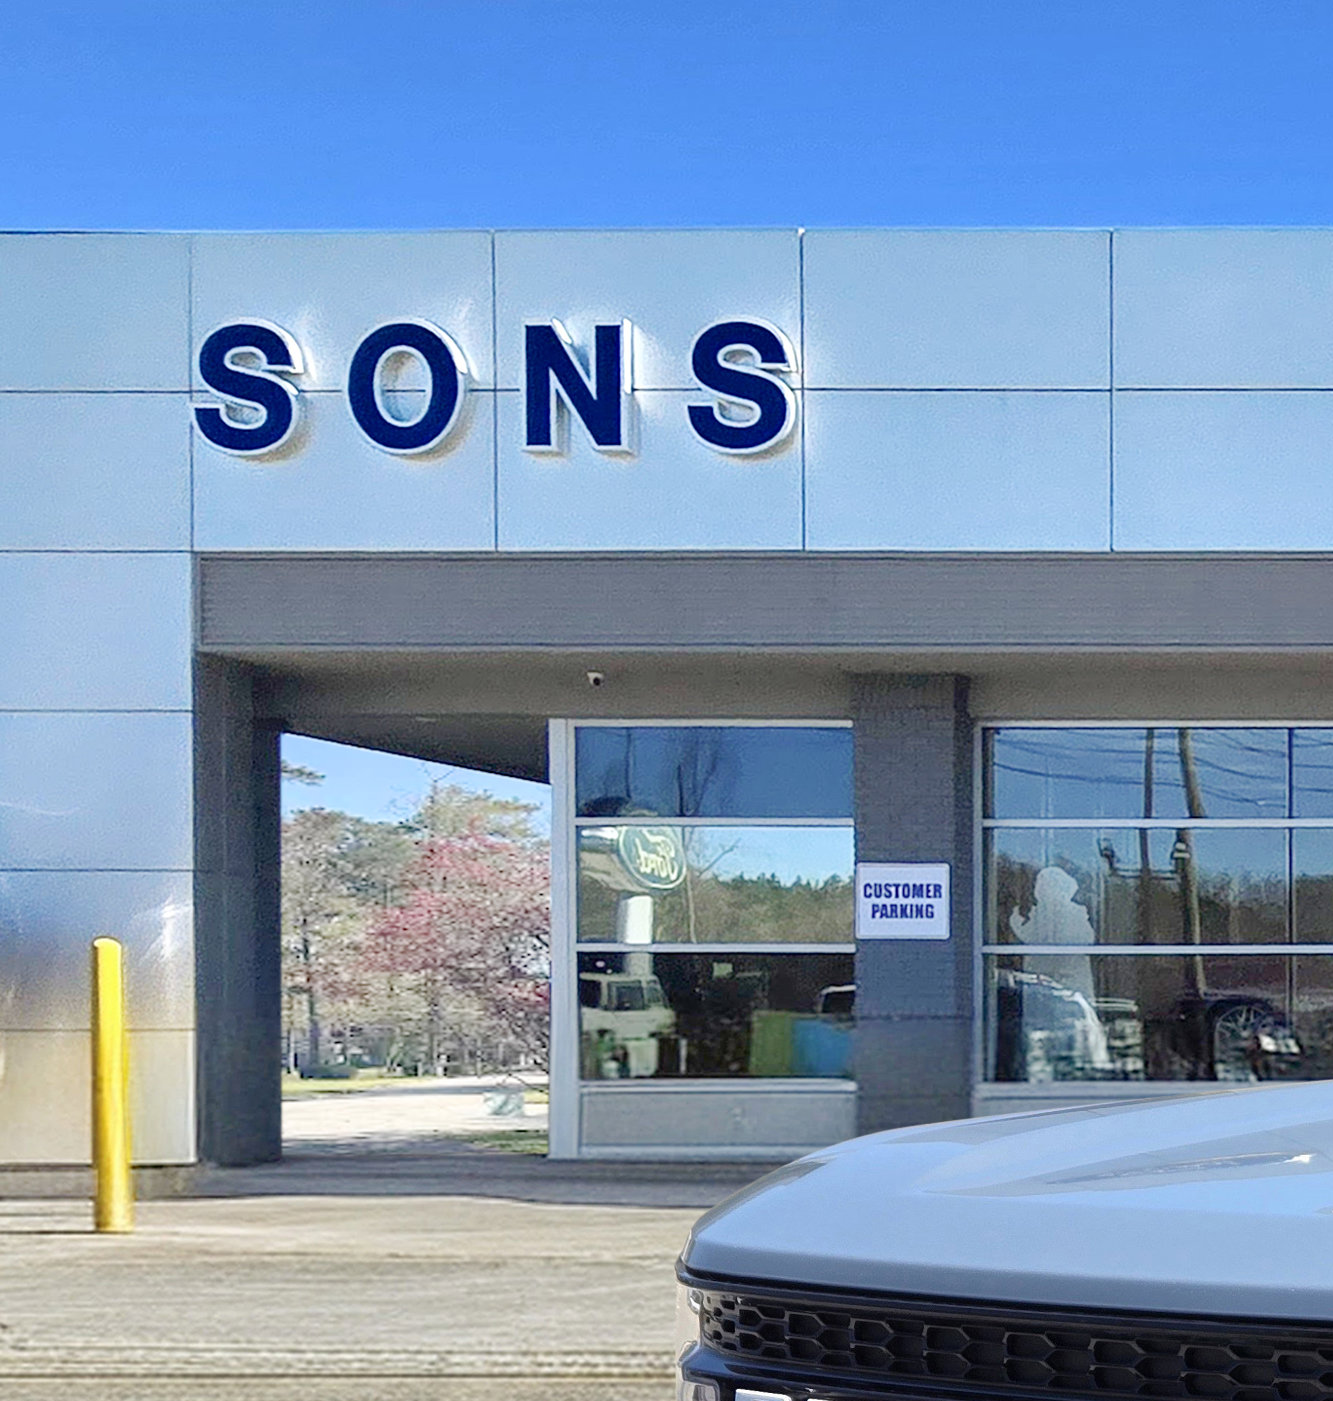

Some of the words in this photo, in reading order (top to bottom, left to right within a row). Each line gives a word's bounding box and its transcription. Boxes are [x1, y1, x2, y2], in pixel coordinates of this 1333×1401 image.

[194, 318, 799, 455] SONS
[863, 882, 943, 899] CUSTOMER
[871, 903, 935, 919] PARKING
